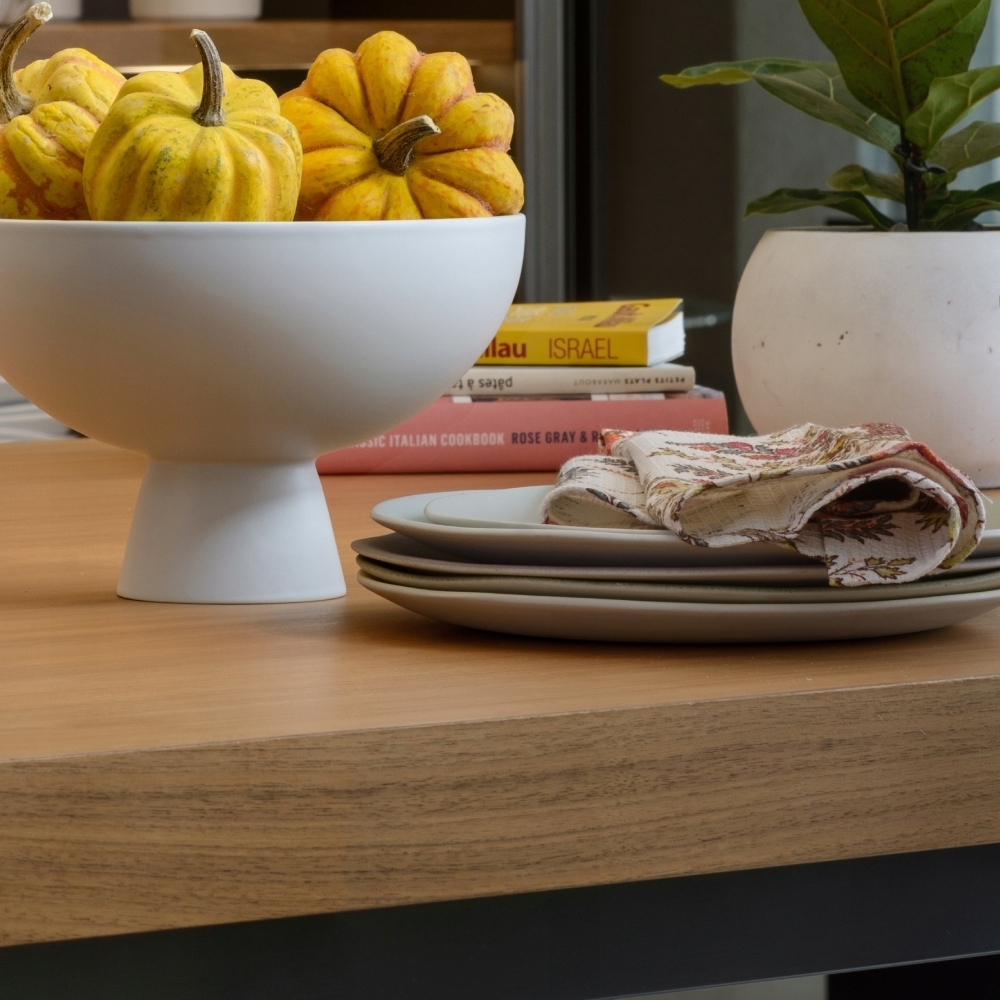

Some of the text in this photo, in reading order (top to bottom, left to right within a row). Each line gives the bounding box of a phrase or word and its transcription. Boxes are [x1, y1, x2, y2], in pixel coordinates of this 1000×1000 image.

[481, 336, 618, 359] llau ISRAEL
[478, 376, 513, 391] pâtes
[389, 433, 437, 448] ITALIAN
[440, 432, 505, 447] COOKBOOK
[511, 432, 541, 444] ROSE
[545, 431, 576, 444] GRAY
[580, 431, 588, 443] &
